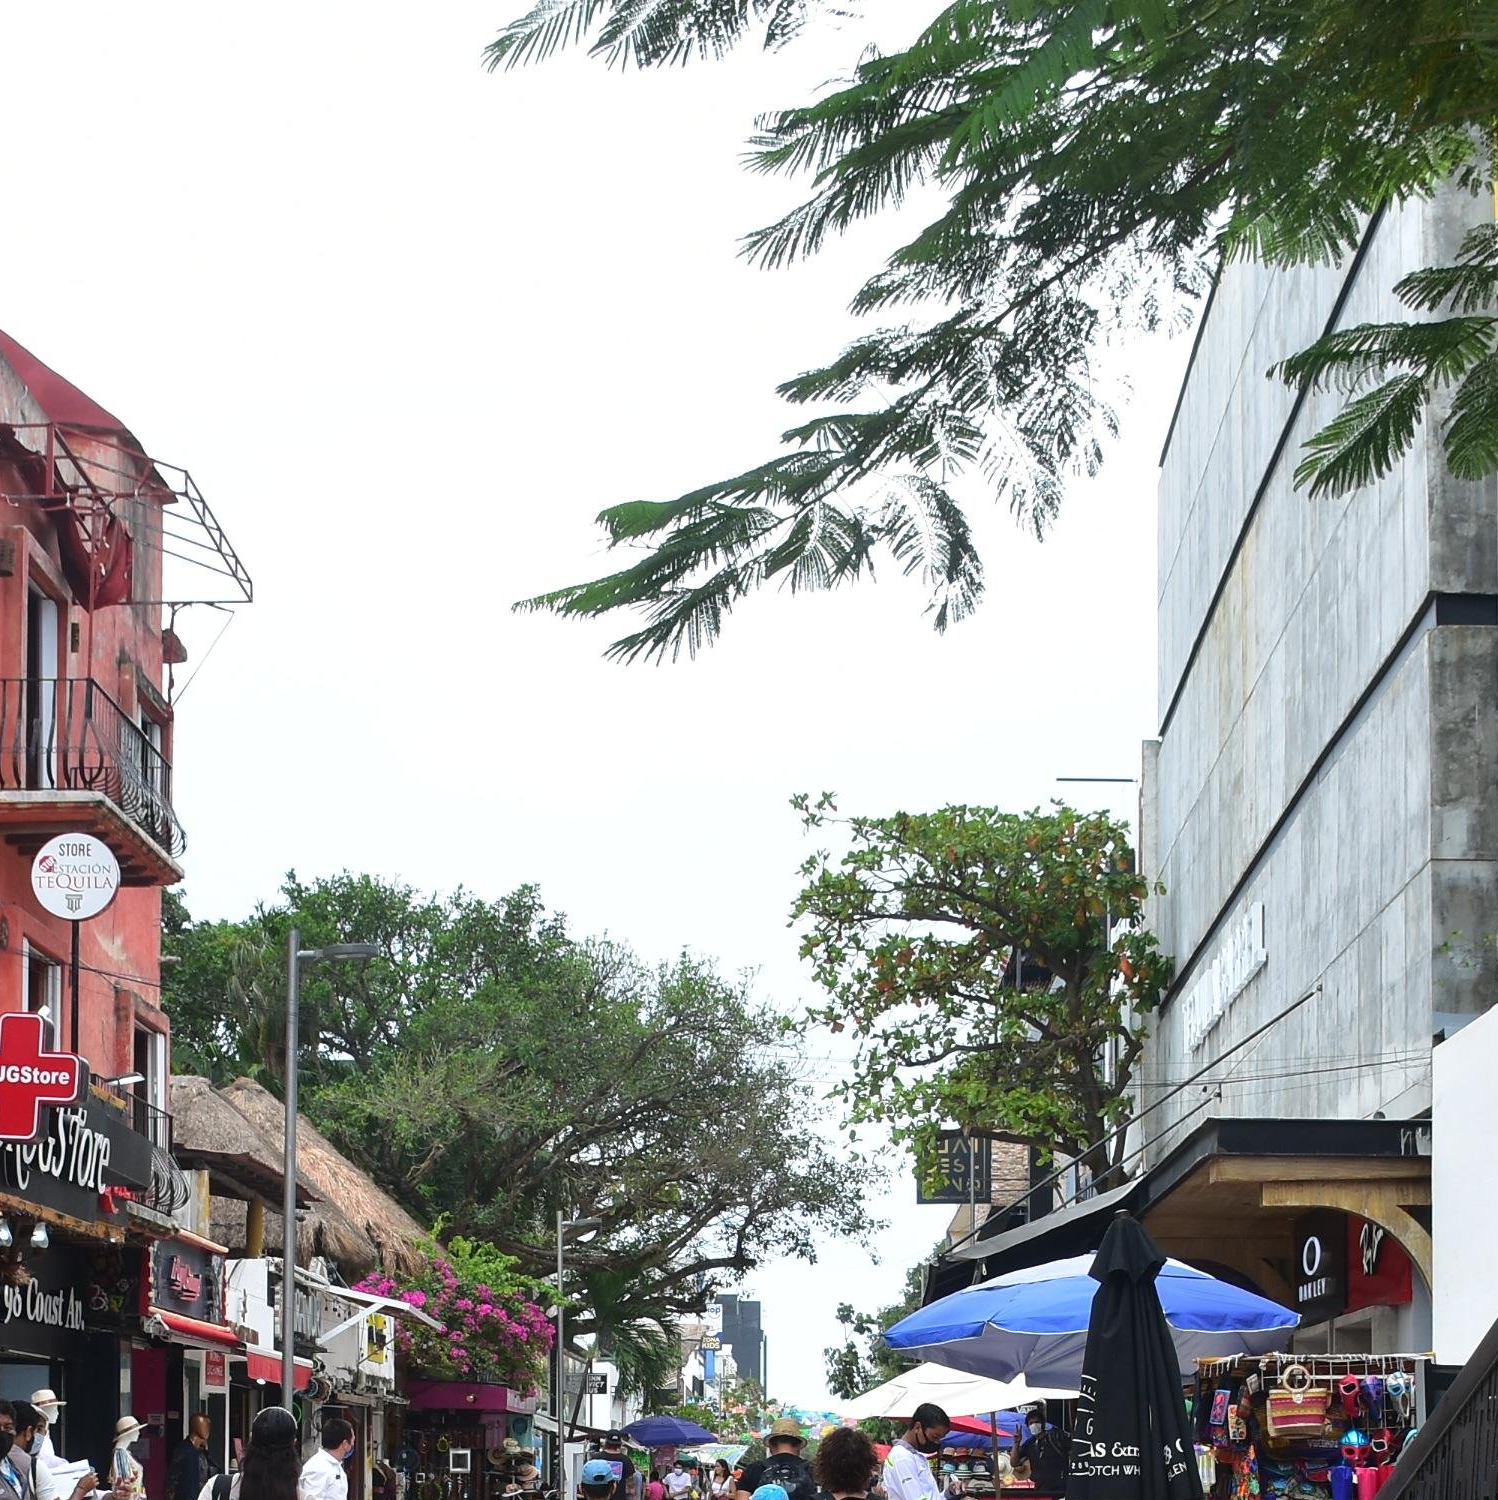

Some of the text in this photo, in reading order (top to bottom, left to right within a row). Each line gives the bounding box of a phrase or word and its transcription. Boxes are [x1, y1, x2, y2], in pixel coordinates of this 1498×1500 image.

[58, 843, 92, 857] STORE
[35, 873, 113, 892] TEQUILA
[26, 1277, 63, 1327] Coast
